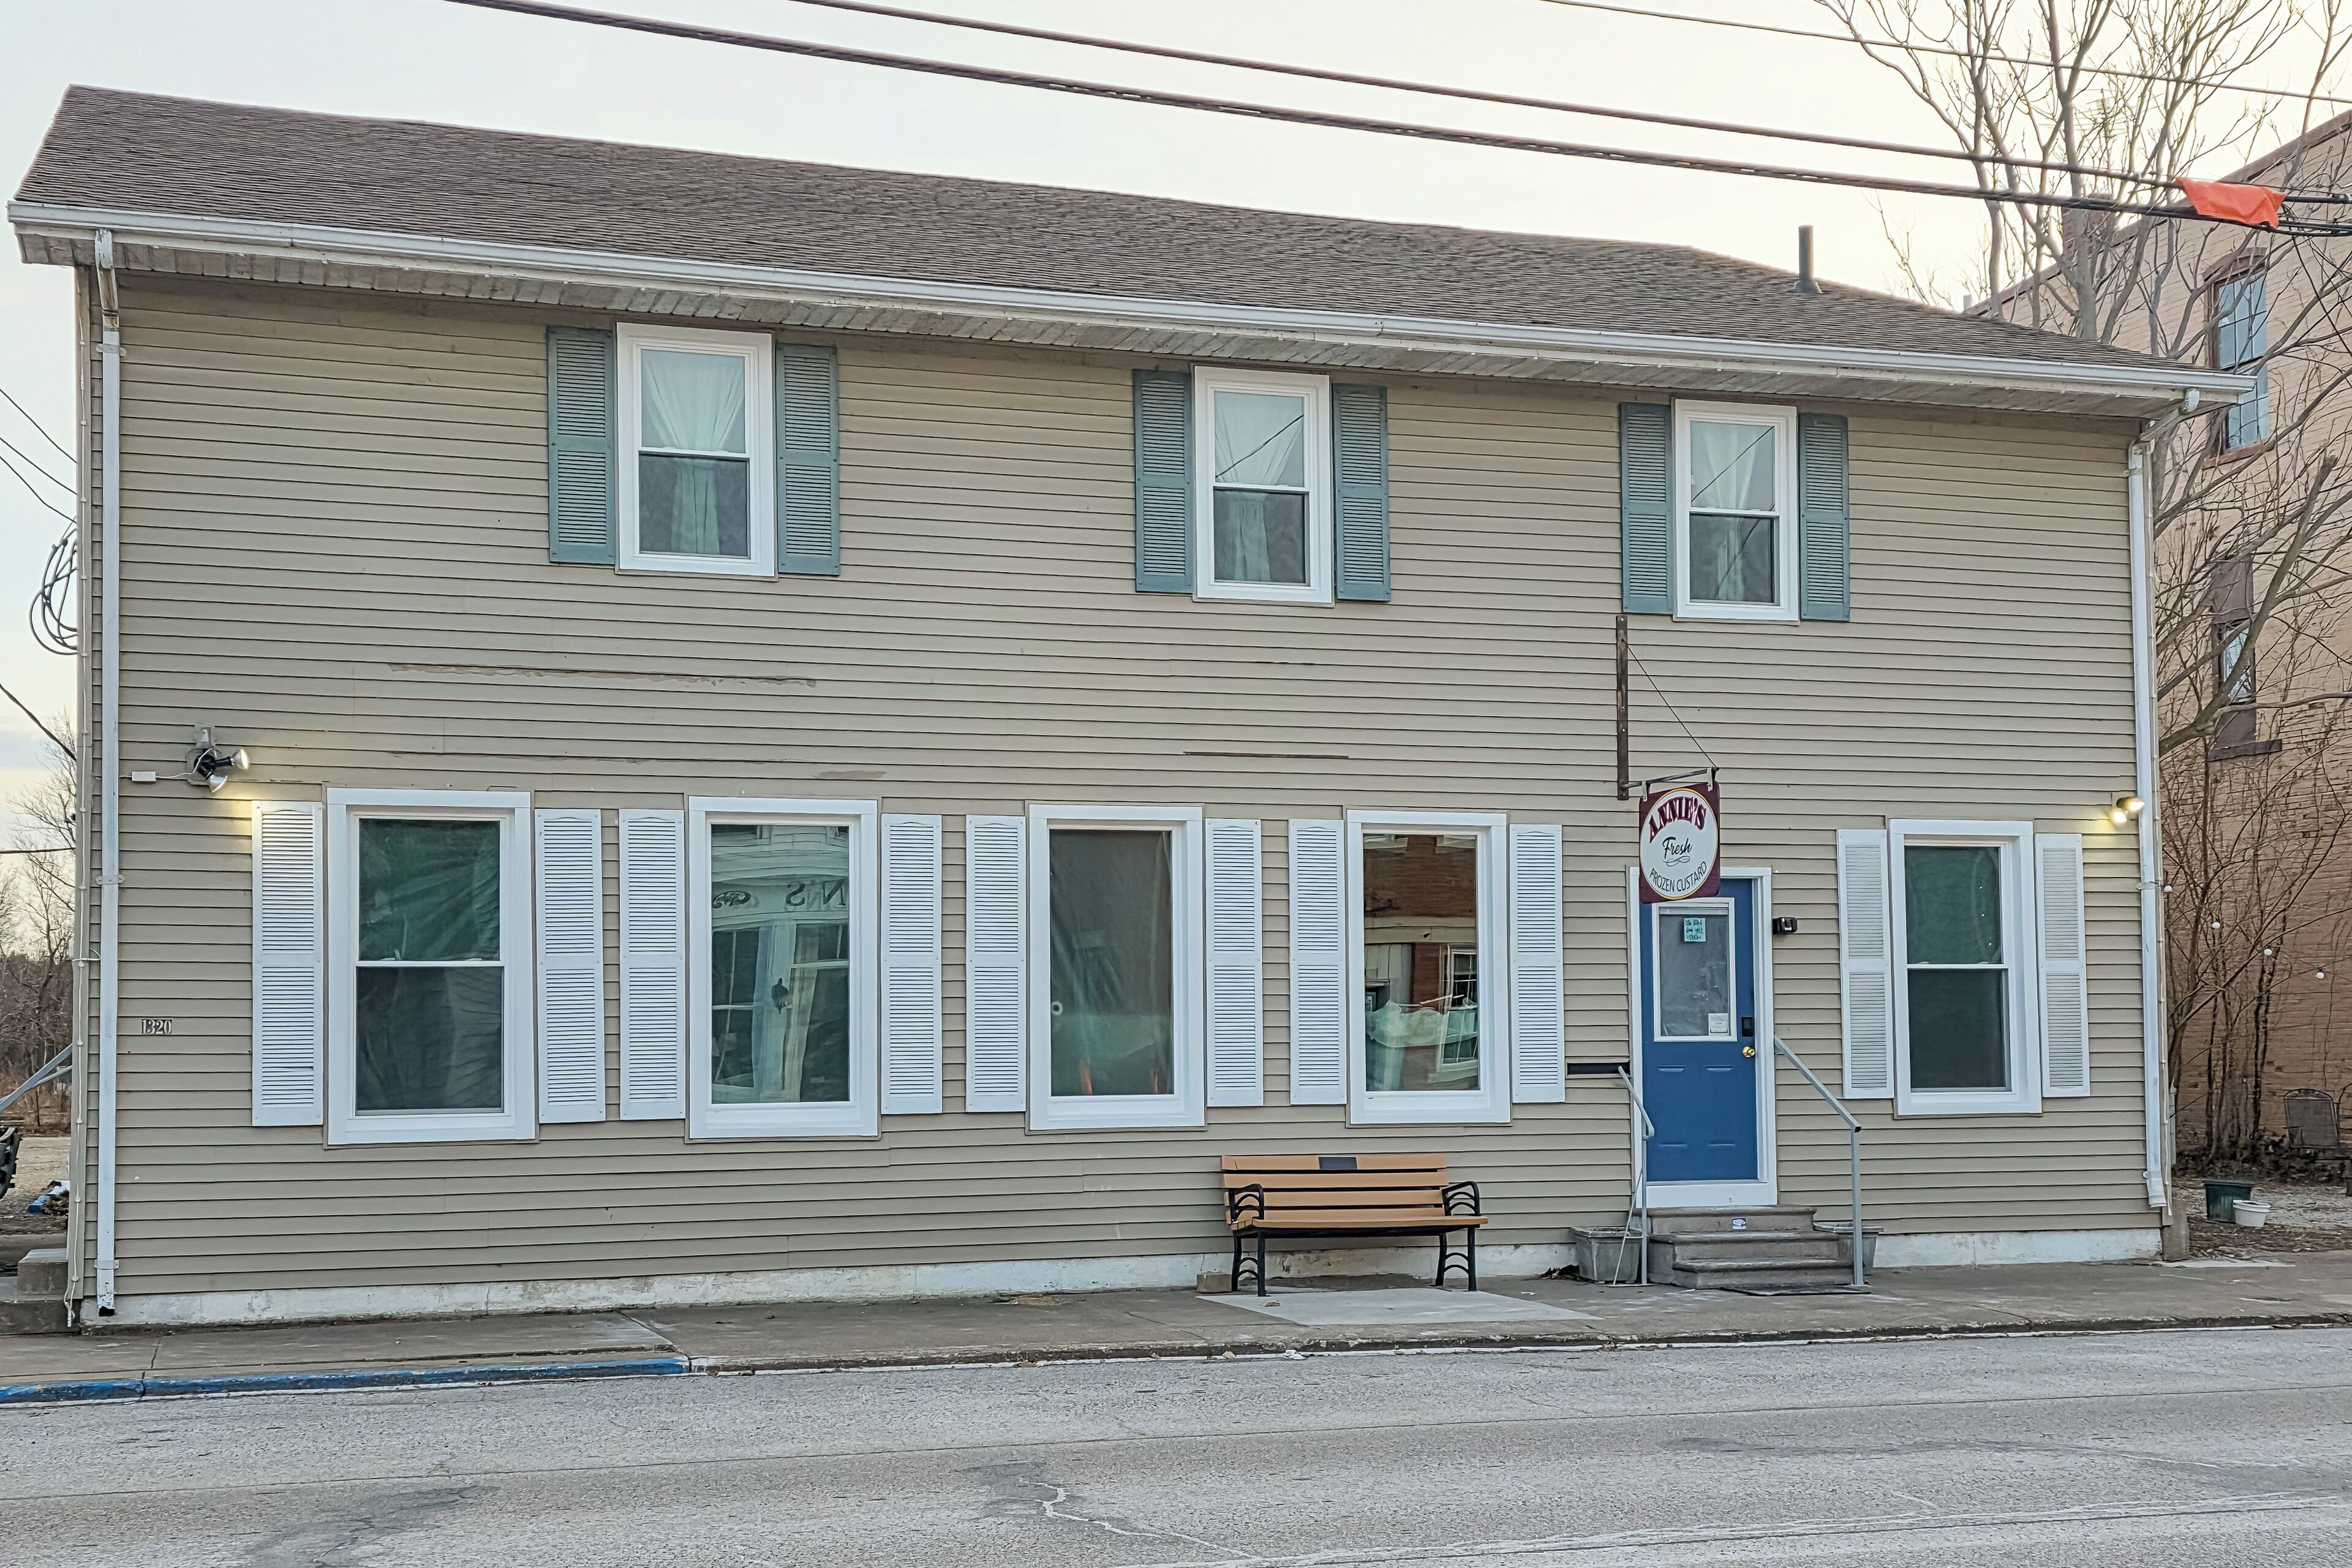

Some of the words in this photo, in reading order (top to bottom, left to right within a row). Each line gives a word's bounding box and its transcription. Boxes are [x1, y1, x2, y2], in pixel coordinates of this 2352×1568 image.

[1648, 796, 1707, 843] ANNIE'S
[1662, 836, 1693, 859] Fresh
[1649, 867, 1675, 892] FROZEN
[1676, 861, 1707, 892] CUSTARD
[141, 1019, 172, 1035] 1320
